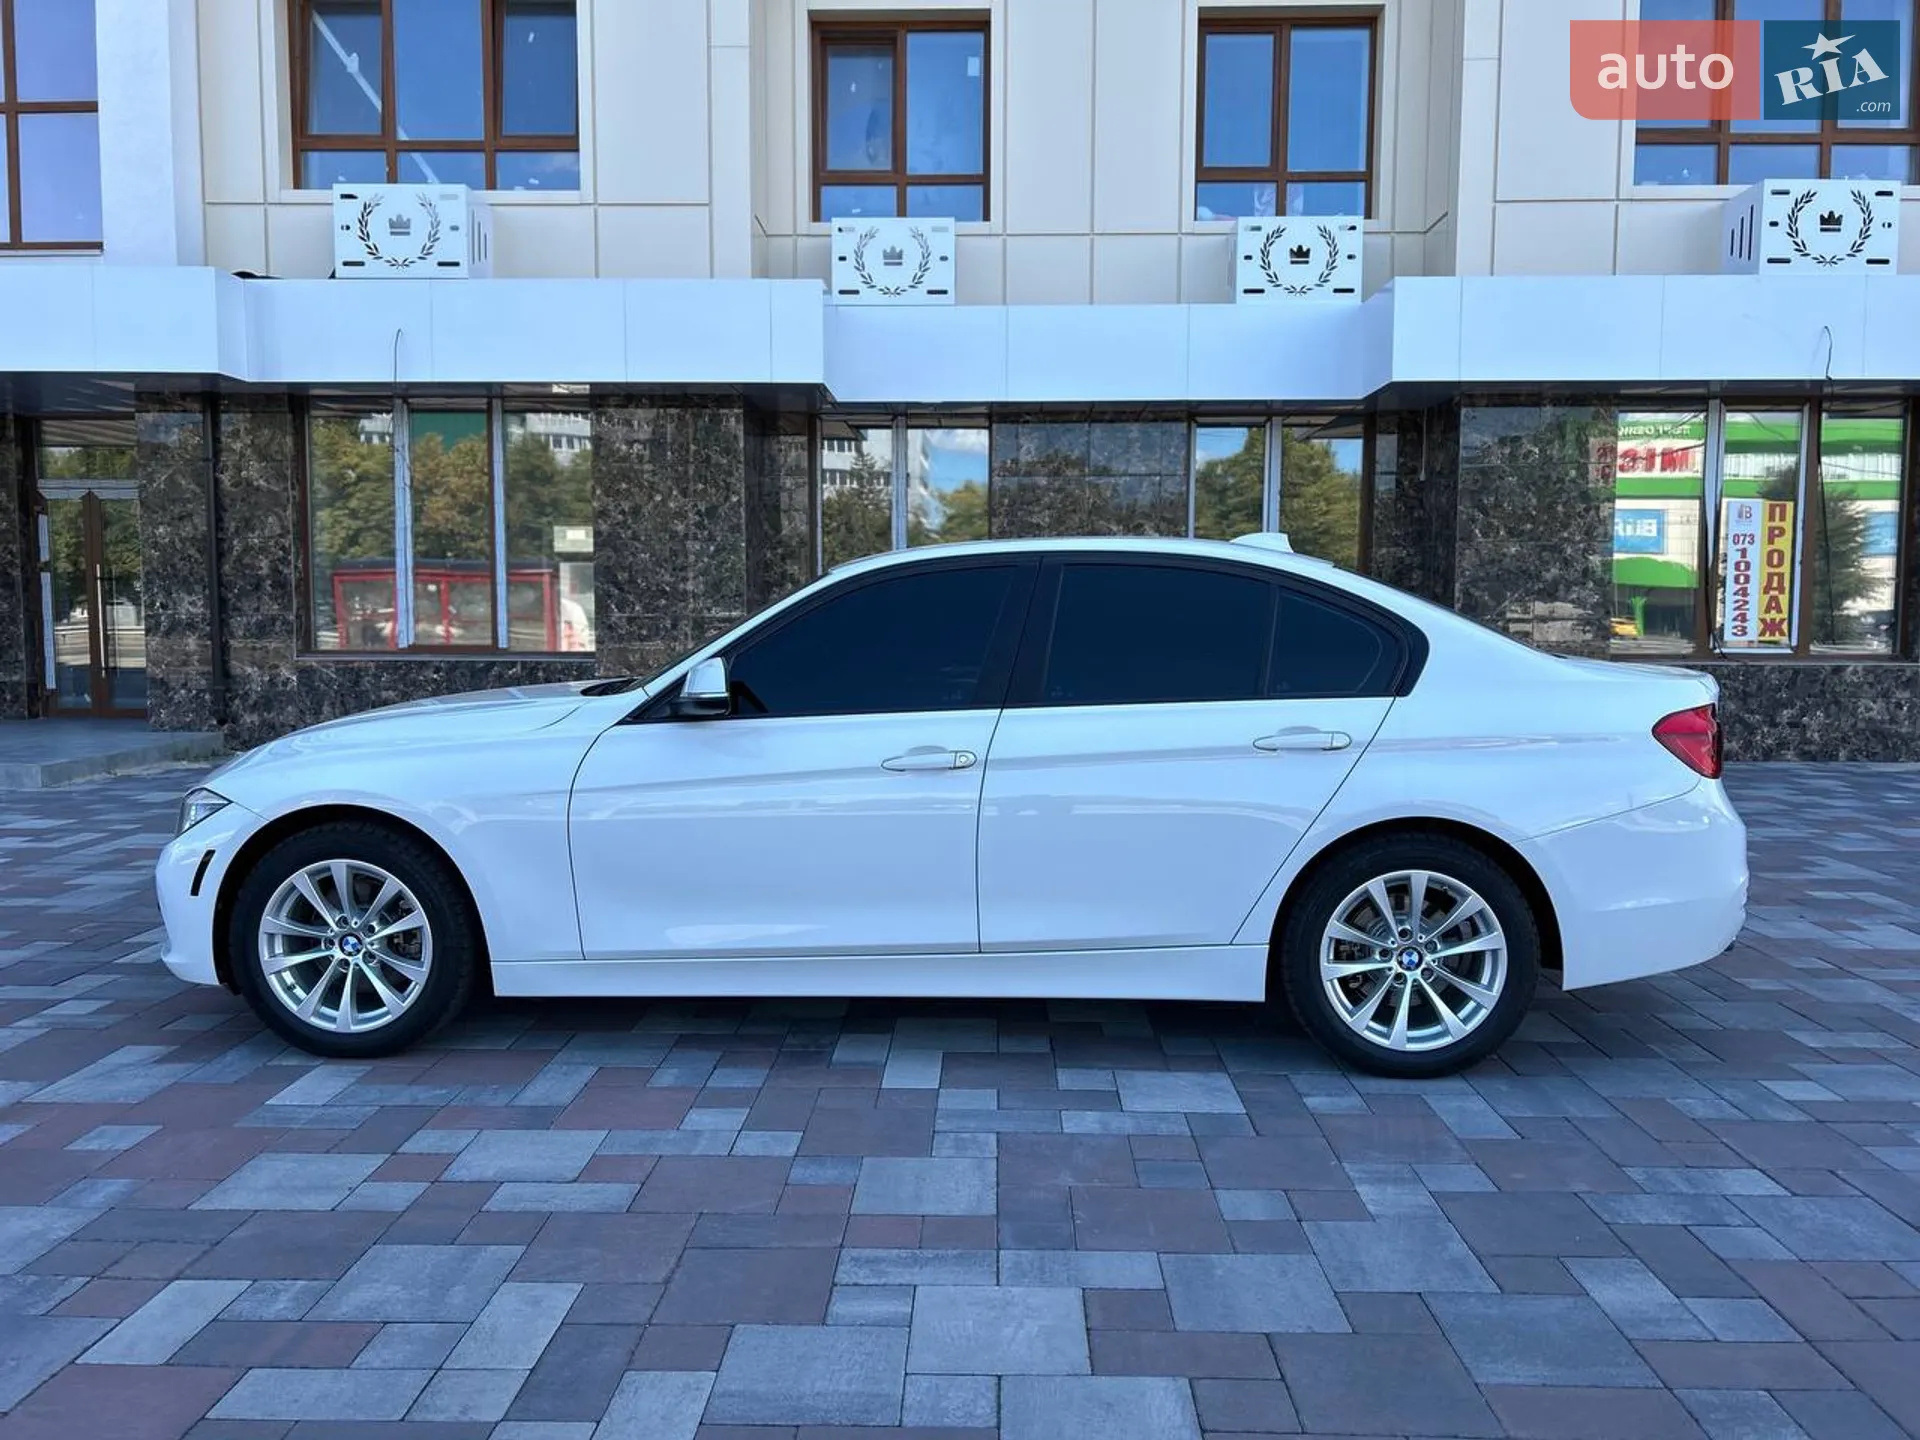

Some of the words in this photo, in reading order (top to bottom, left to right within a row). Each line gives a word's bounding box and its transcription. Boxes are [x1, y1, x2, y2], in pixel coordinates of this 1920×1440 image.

[1732, 533, 1756, 546] 073
[1758, 502, 1787, 637] ПРОДАЖ
[1731, 547, 1752, 637] 1004243
